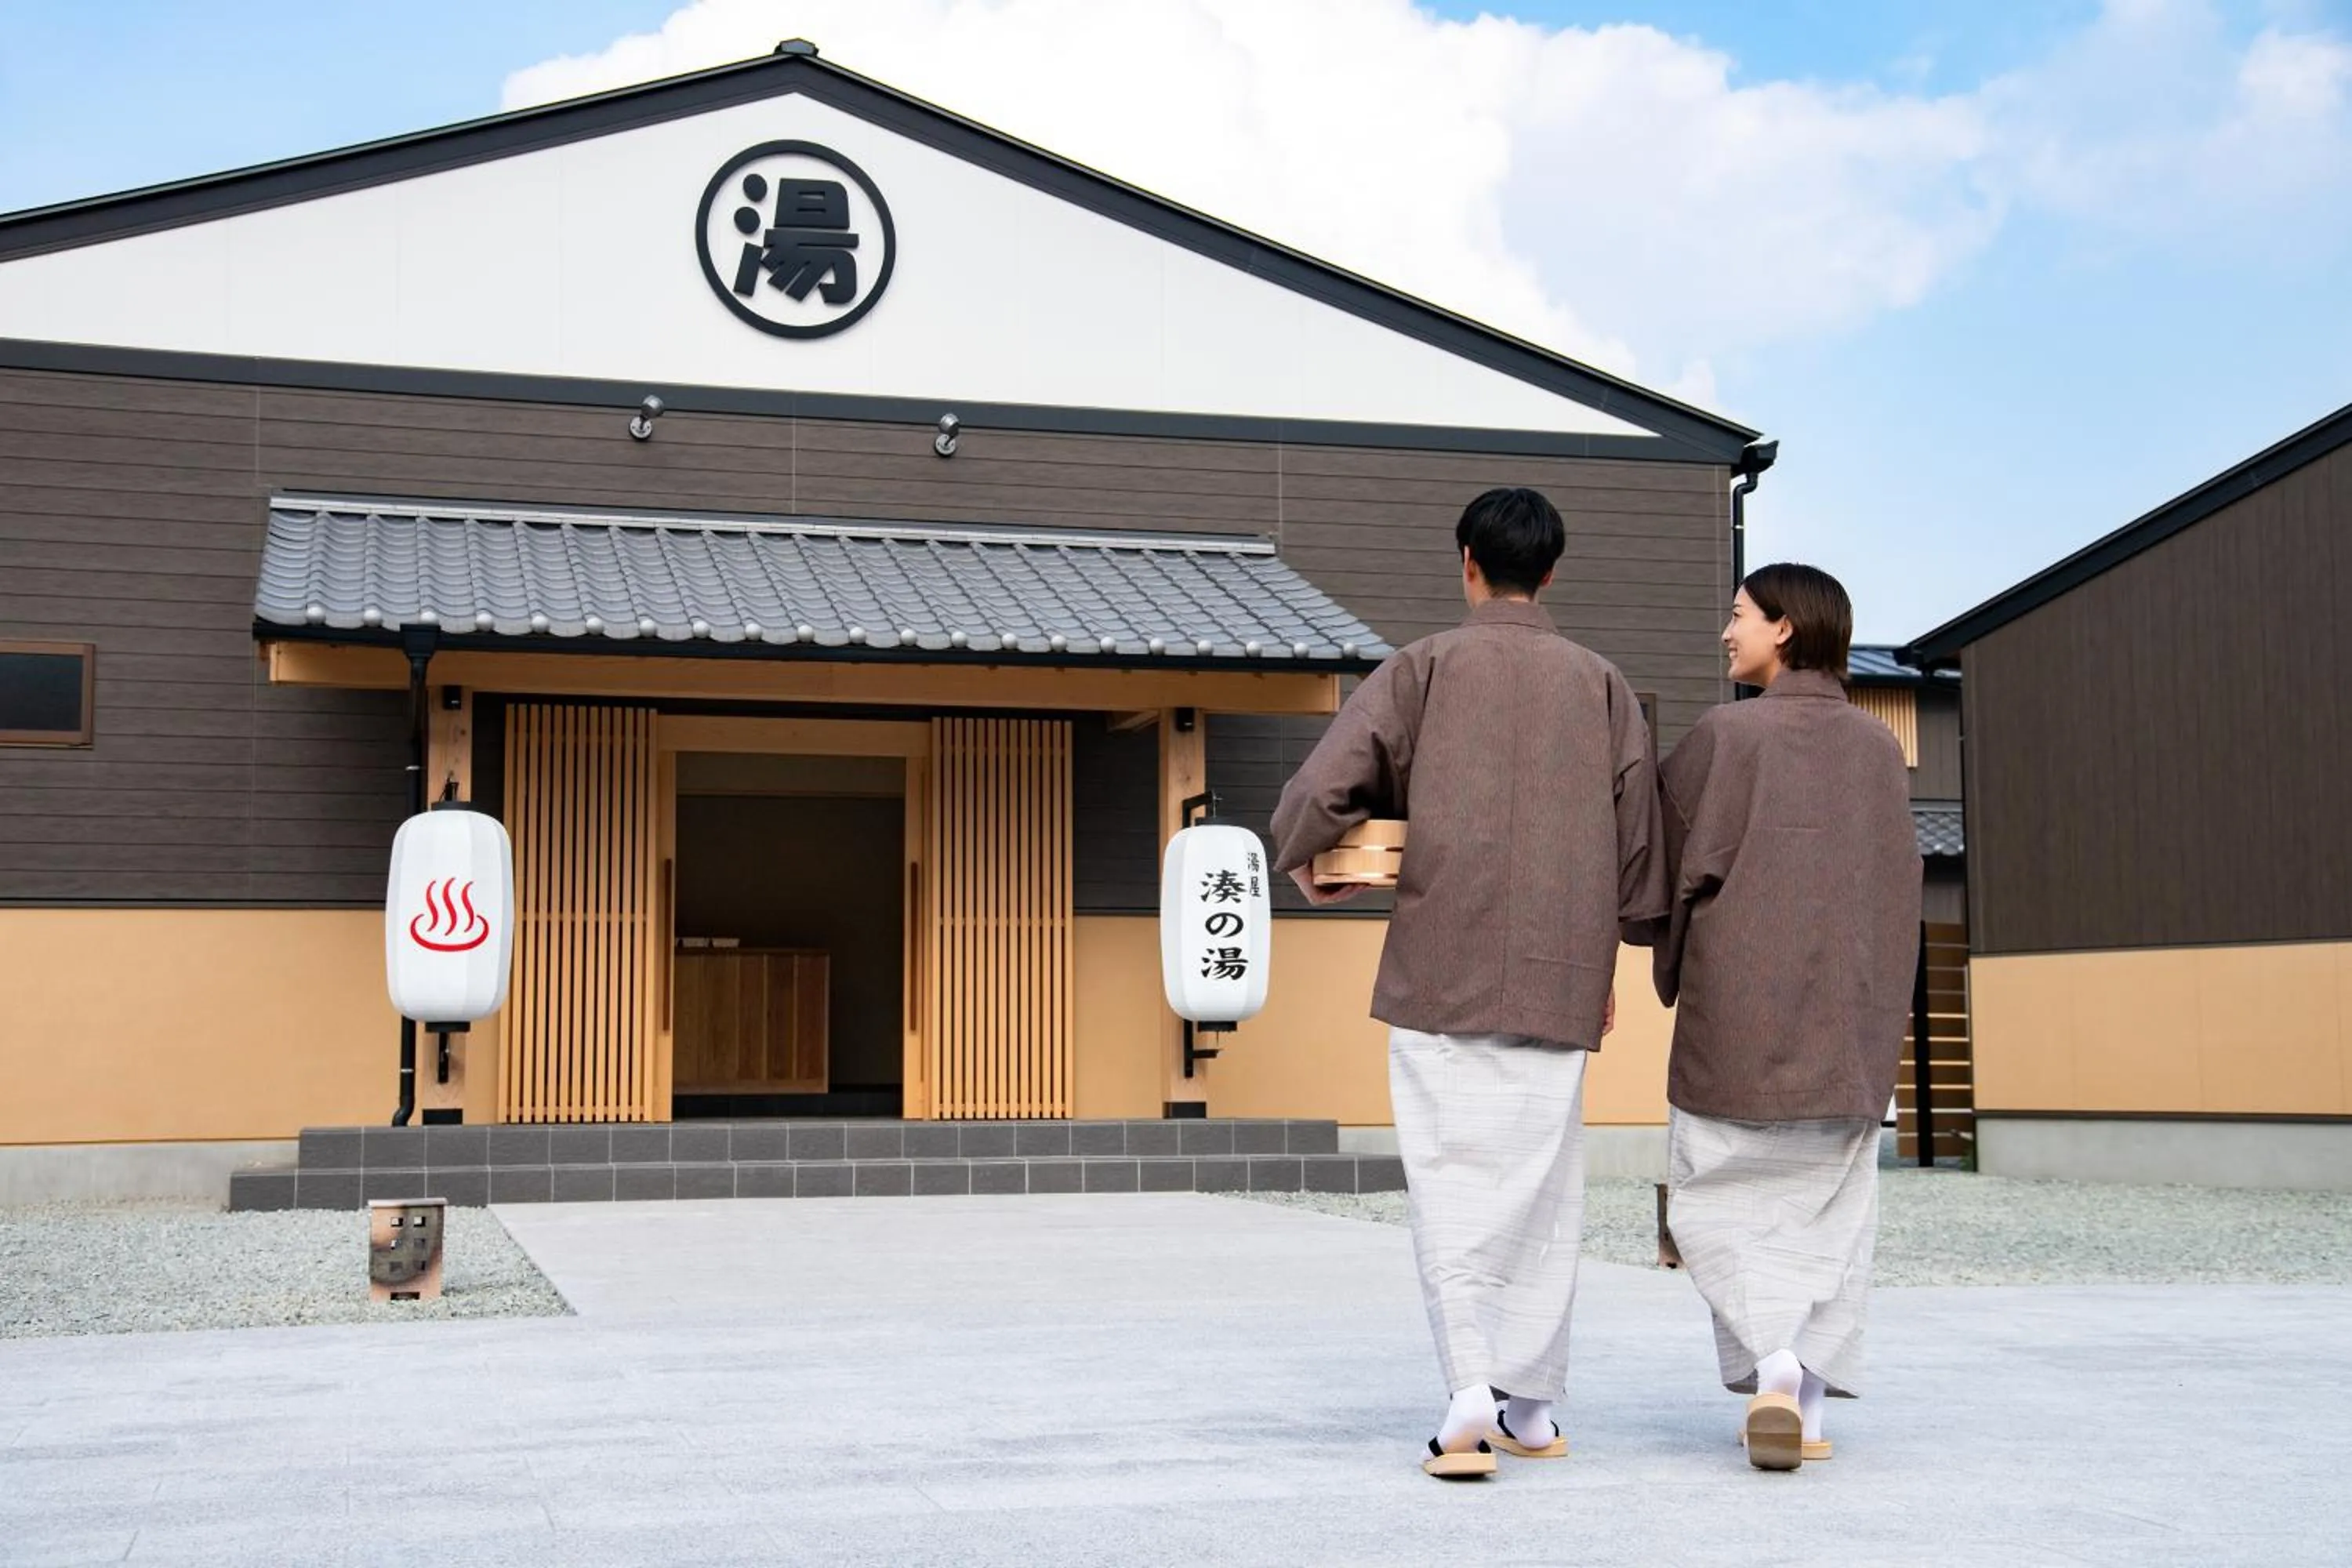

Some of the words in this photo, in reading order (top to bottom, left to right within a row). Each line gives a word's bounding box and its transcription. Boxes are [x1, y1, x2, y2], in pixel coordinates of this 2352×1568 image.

[733, 173, 859, 305] 湯
[1200, 869, 1249, 980] 湊の湯
